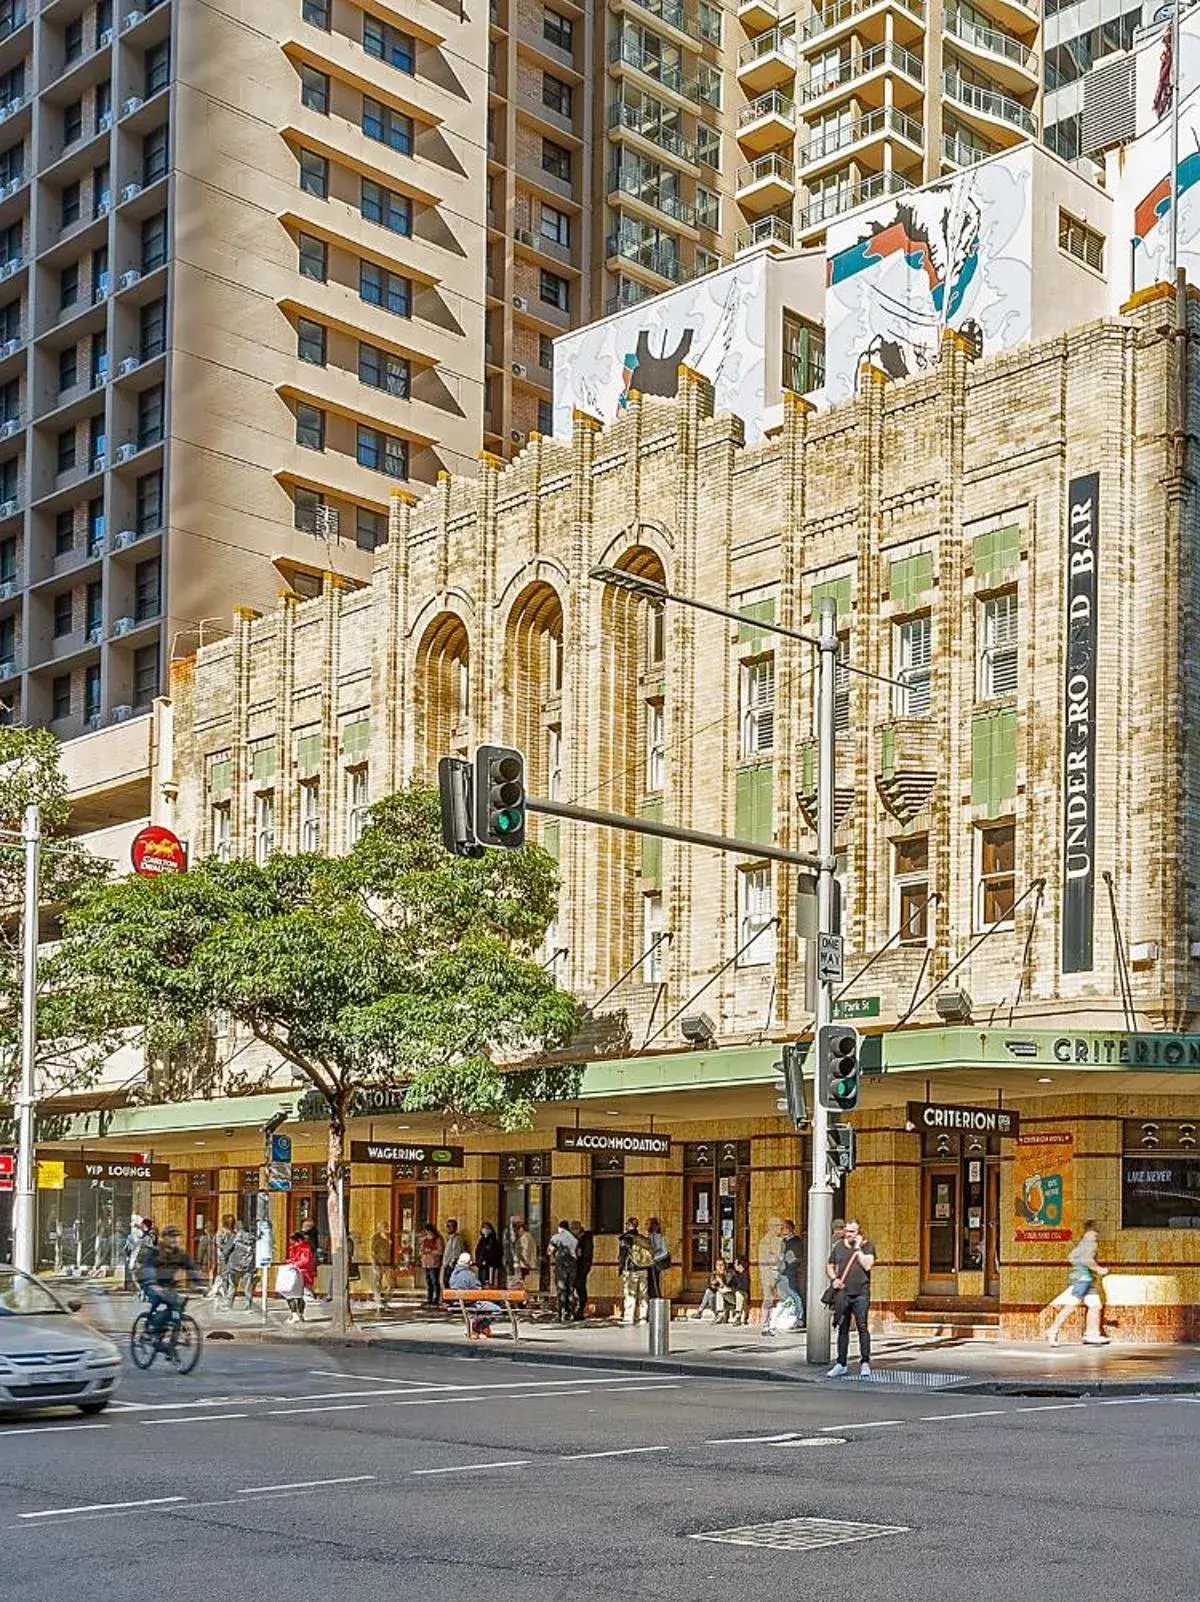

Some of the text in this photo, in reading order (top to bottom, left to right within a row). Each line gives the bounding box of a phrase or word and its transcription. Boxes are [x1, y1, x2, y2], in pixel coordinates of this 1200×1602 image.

[1066, 498, 1094, 880] UNDERGROUND BAR
[822, 938, 840, 950] ONE
[820, 952, 841, 965] WAY
[923, 1108, 996, 1131] CRITERION
[576, 1135, 669, 1152] ACCOMMODATION
[367, 1146, 425, 1162] WAGERING
[86, 1165, 151, 1178] VIP LOUNGE
